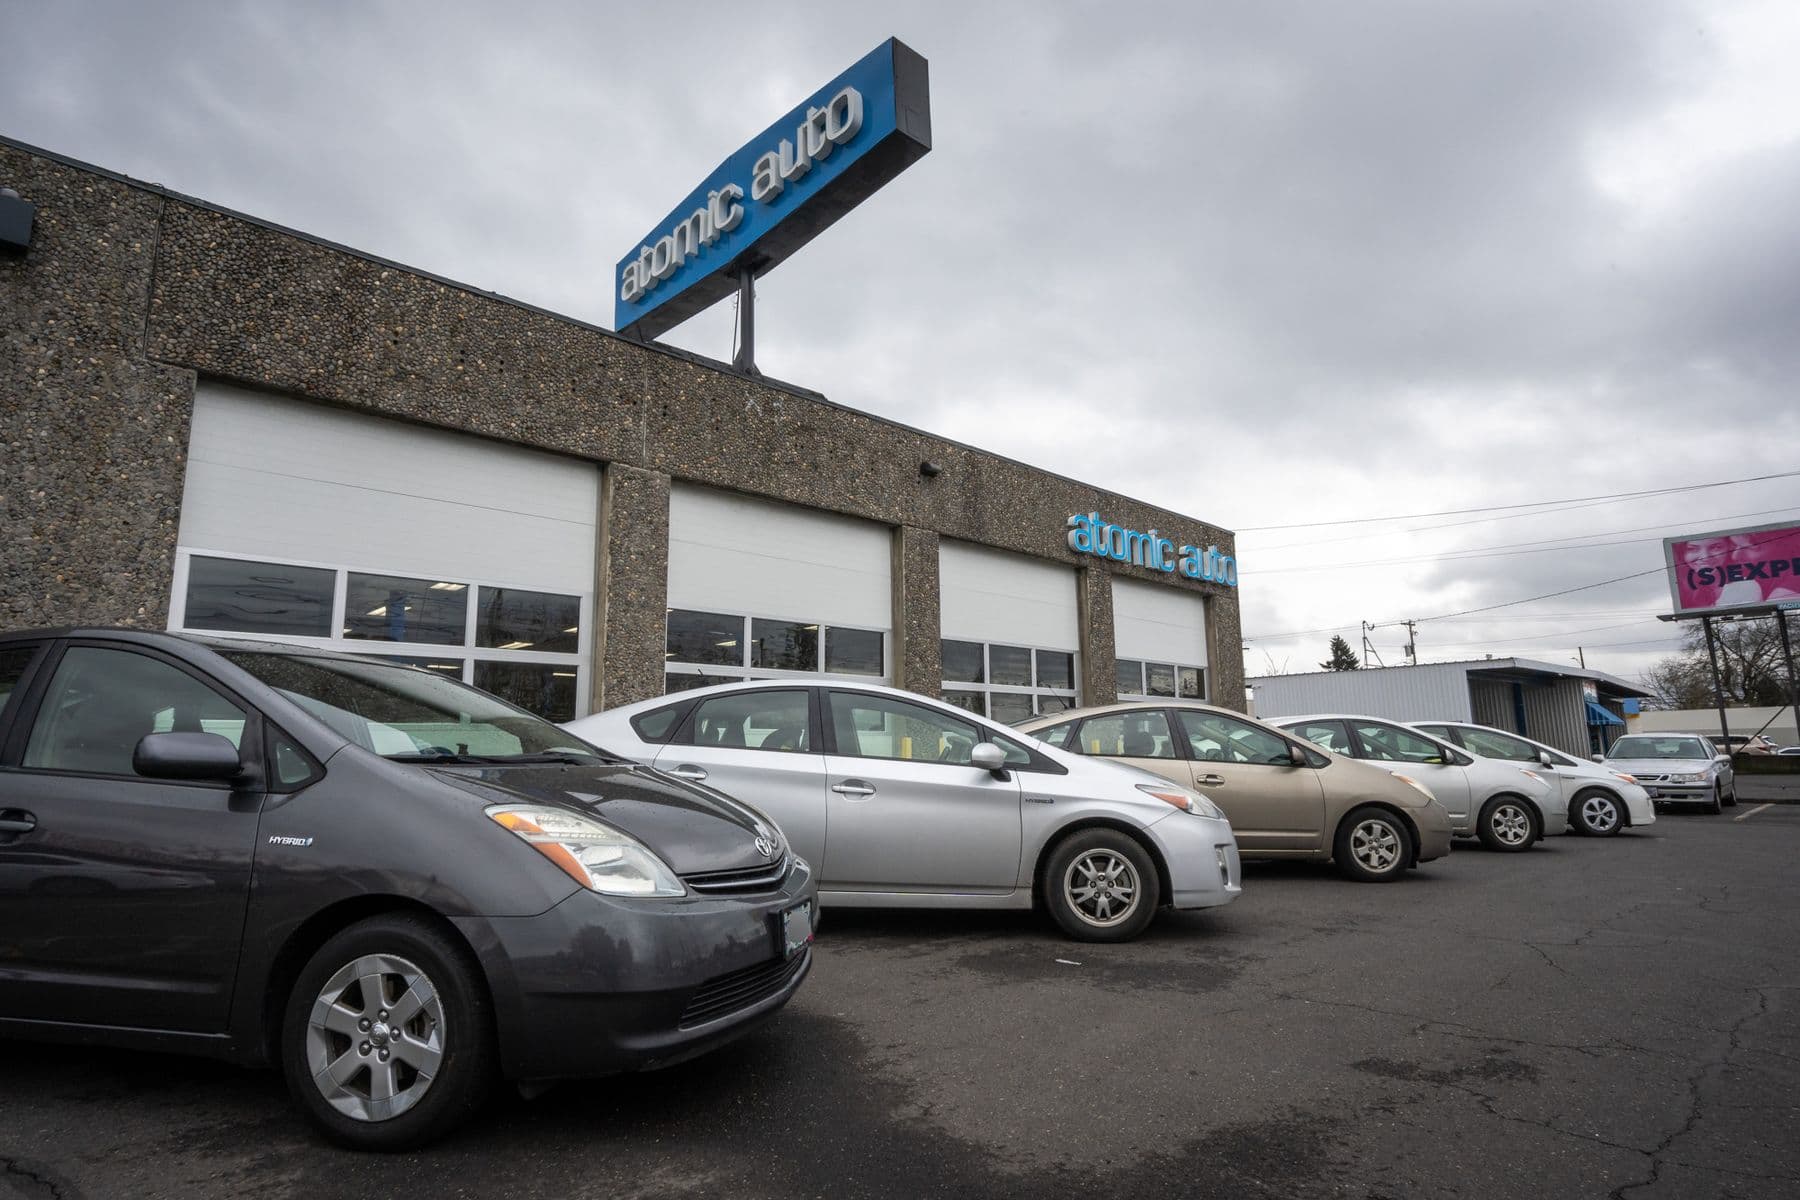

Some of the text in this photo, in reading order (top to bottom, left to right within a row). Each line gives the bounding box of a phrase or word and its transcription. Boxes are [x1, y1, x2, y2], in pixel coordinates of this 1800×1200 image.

[621, 86, 864, 302] atomic auto
[1067, 511, 1238, 587] atomic auto
[269, 836, 305, 846] HYBRID
